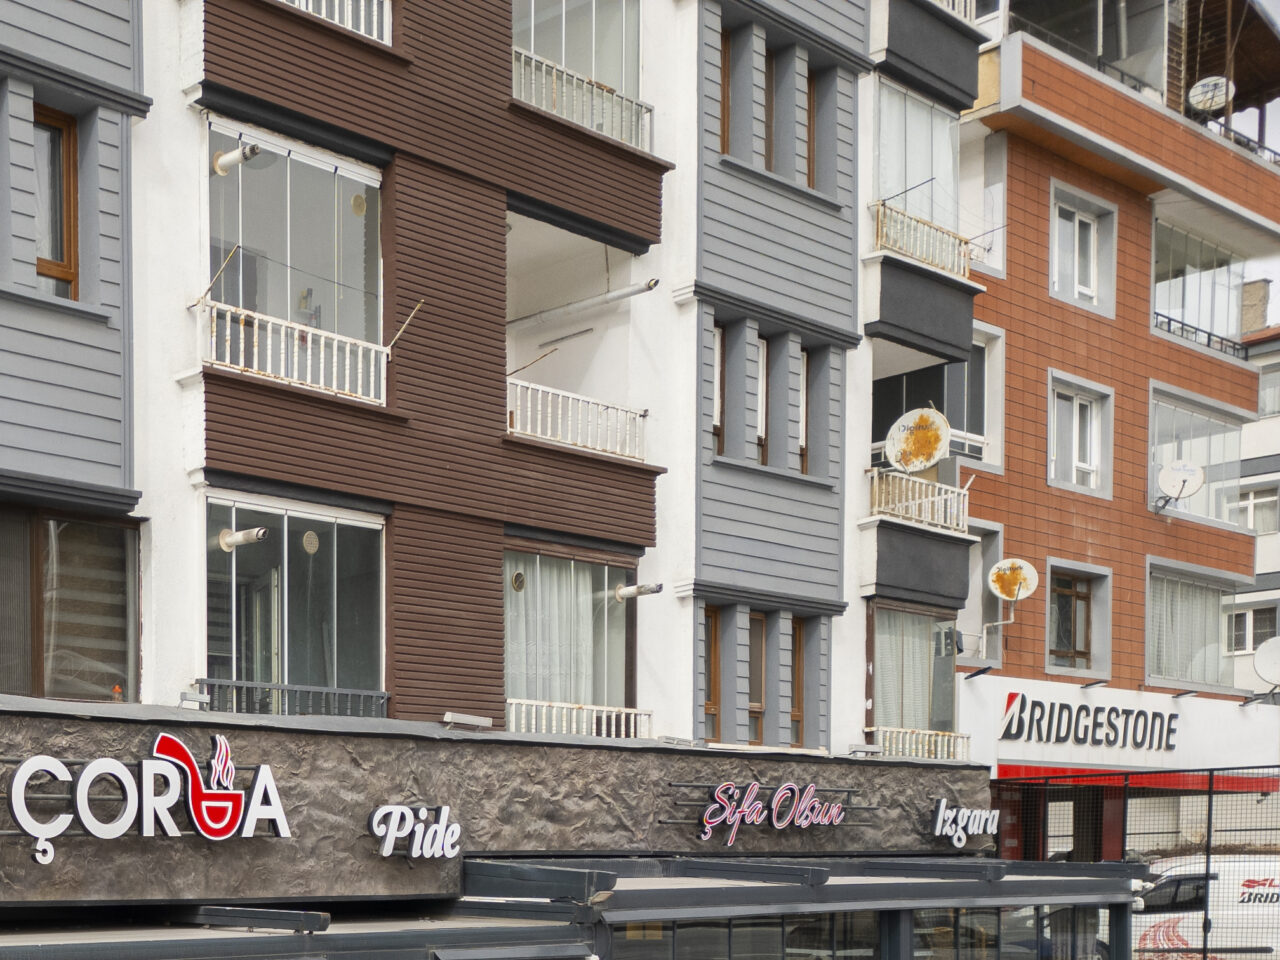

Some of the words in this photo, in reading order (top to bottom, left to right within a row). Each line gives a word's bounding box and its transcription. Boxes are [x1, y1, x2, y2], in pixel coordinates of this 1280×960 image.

[999, 692, 1179, 750] BRIDGESTONE
[11, 731, 291, 864] ÇORBA
[701, 782, 768, 846] Şifa
[771, 782, 846, 829] Olsun
[934, 798, 1001, 848] Izgara
[376, 804, 462, 859] Pide
